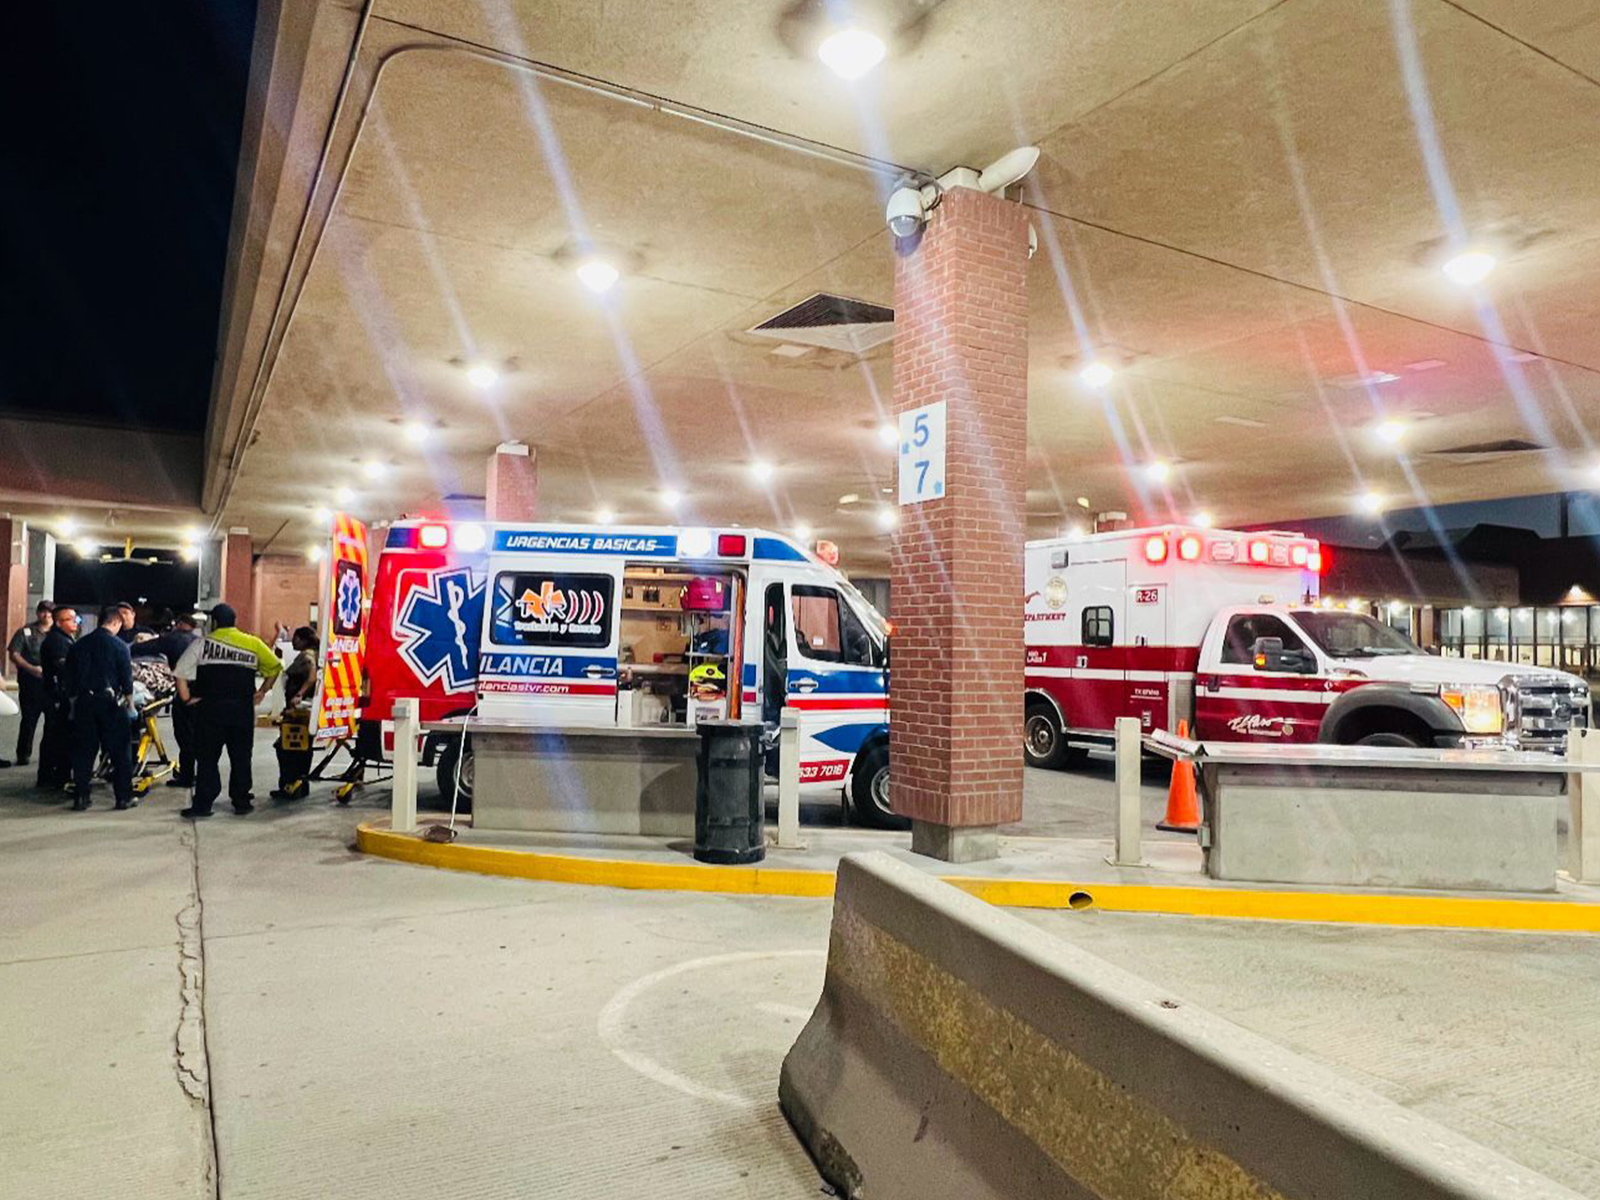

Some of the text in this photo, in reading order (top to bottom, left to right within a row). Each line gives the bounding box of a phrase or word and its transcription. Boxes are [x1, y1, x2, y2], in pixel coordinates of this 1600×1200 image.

[913, 413, 929, 447] 5
[914, 460, 930, 494] 7
[507, 535, 658, 551] URGENCIAS BASICAS
[1136, 590, 1158, 602] R-26
